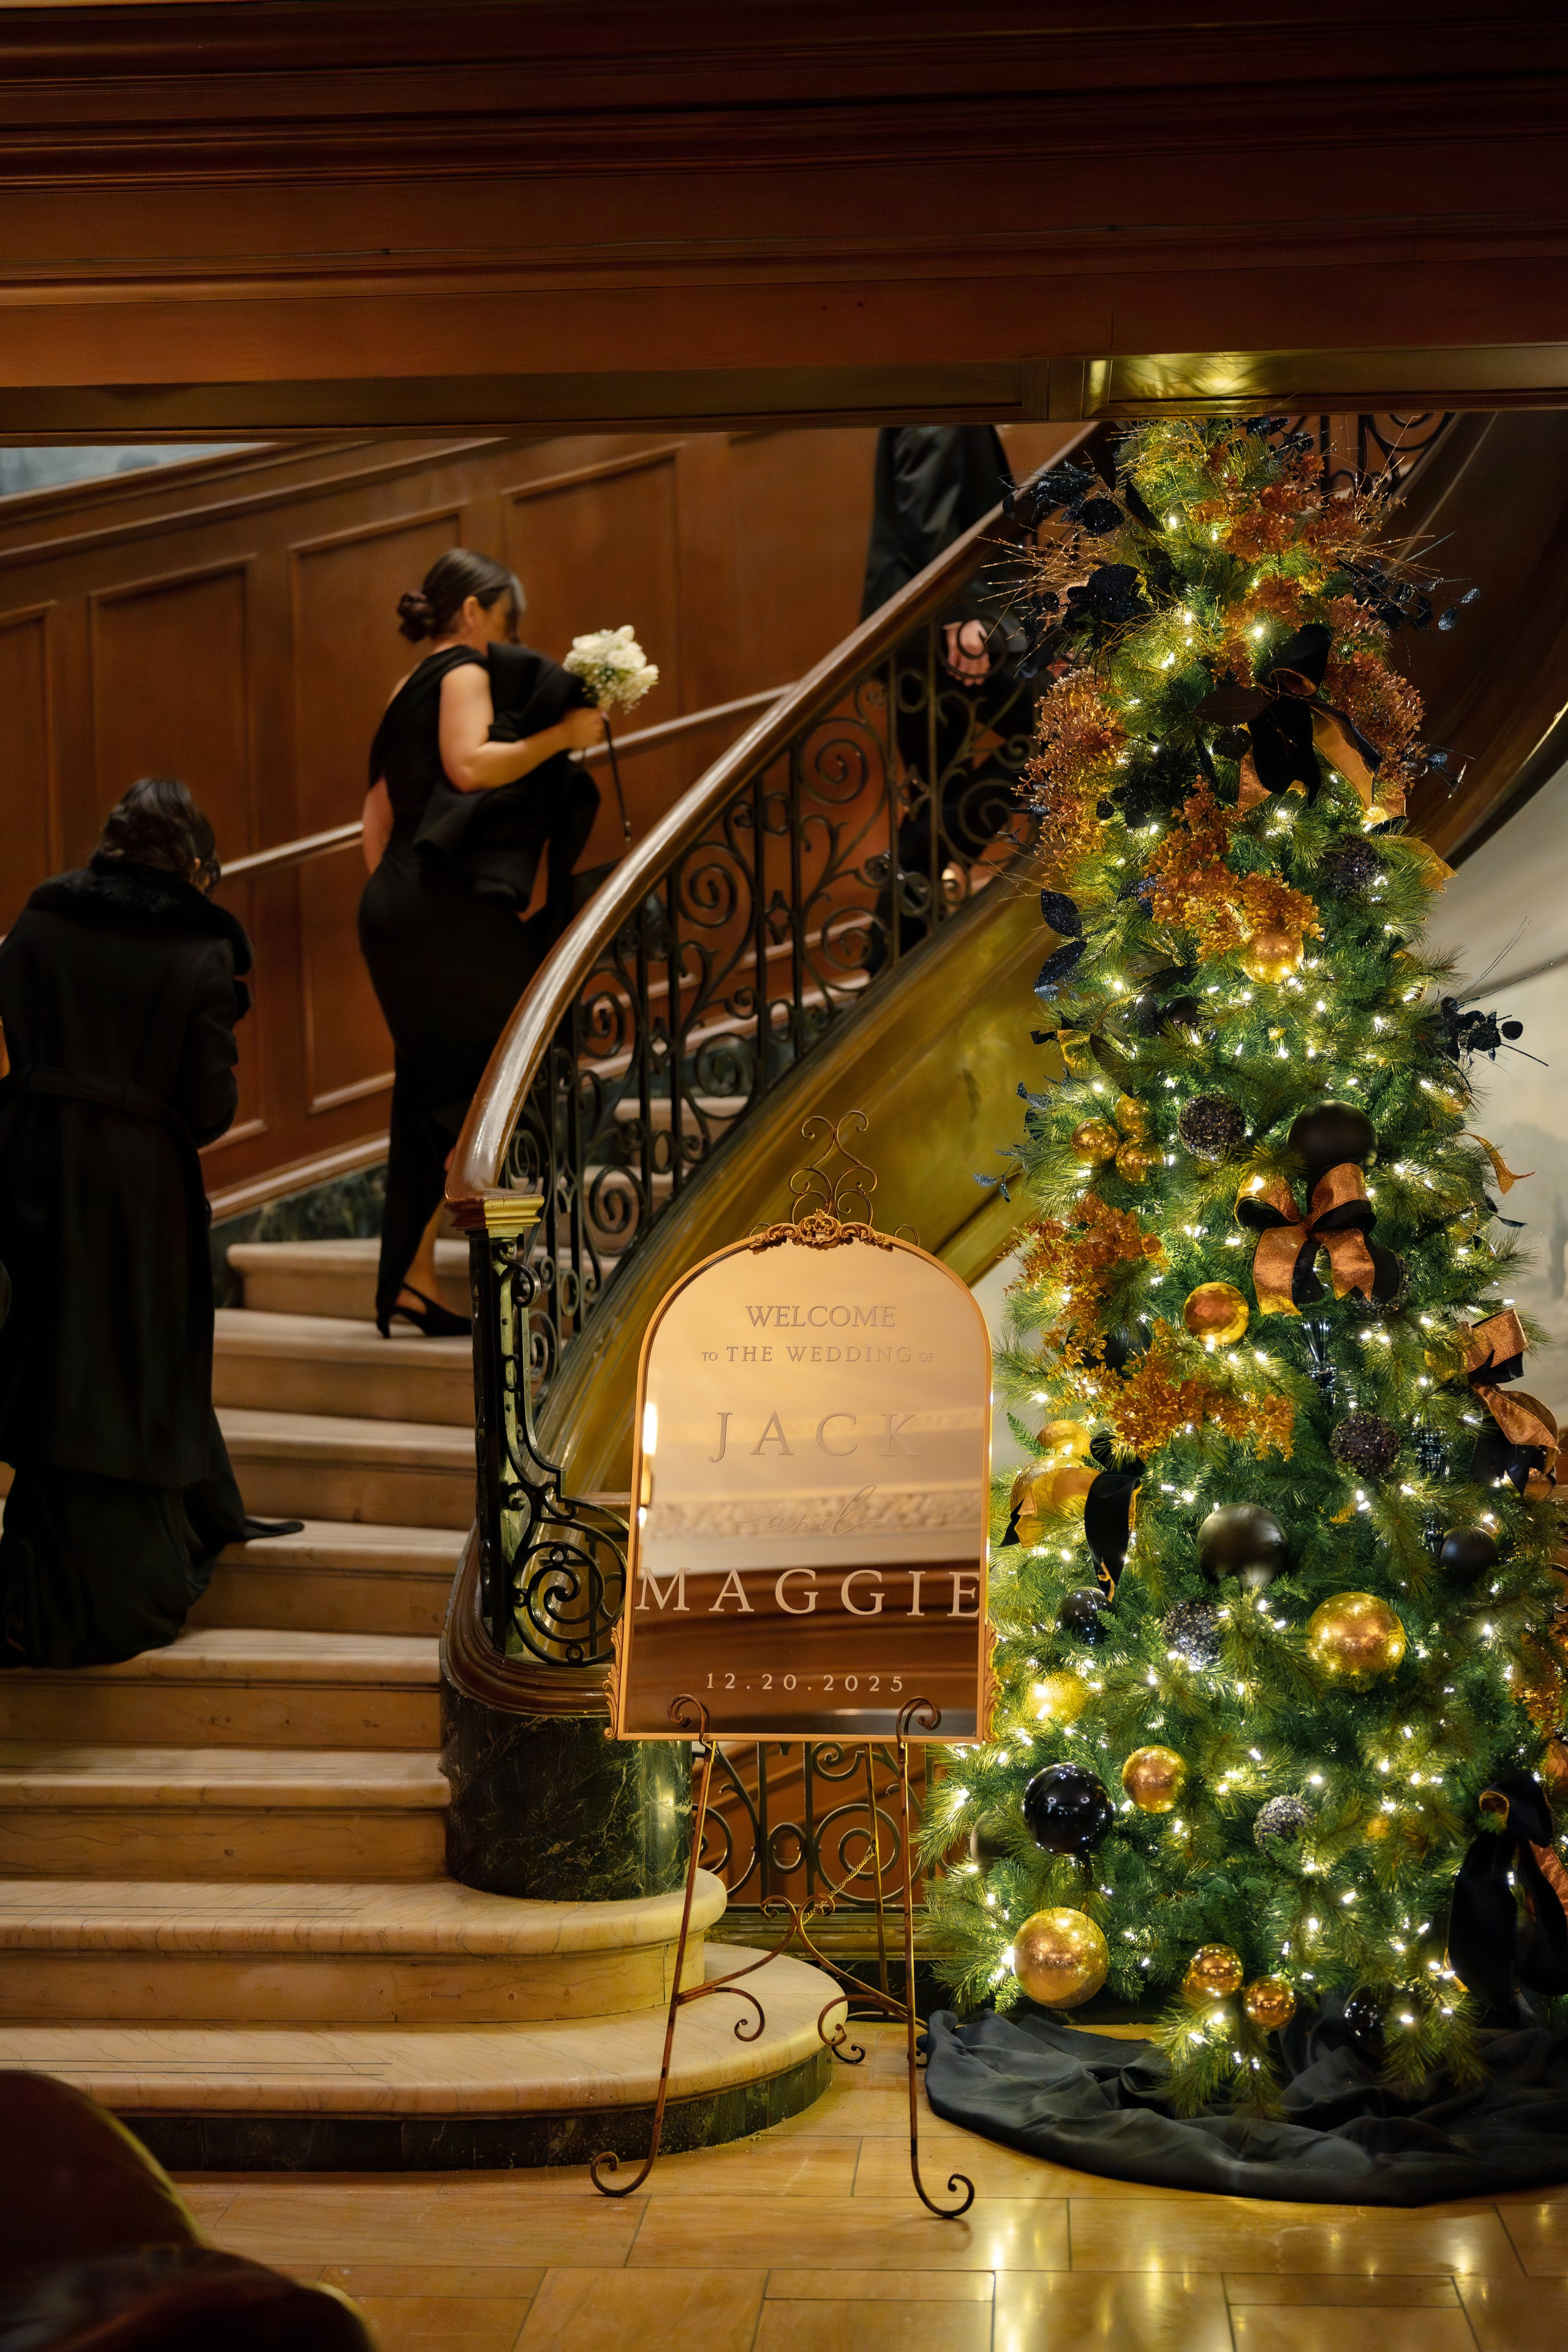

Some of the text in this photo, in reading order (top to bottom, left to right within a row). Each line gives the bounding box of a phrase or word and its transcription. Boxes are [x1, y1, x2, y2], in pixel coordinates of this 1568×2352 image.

[744, 1305, 896, 1328] WELCOME
[701, 1346, 935, 1363] TO THE WEDDING OF
[708, 1411, 919, 1463] JACK
[732, 1484, 888, 1537] and
[635, 1566, 980, 1618] MAGGIE
[706, 1673, 903, 1692] 12.20.2025
